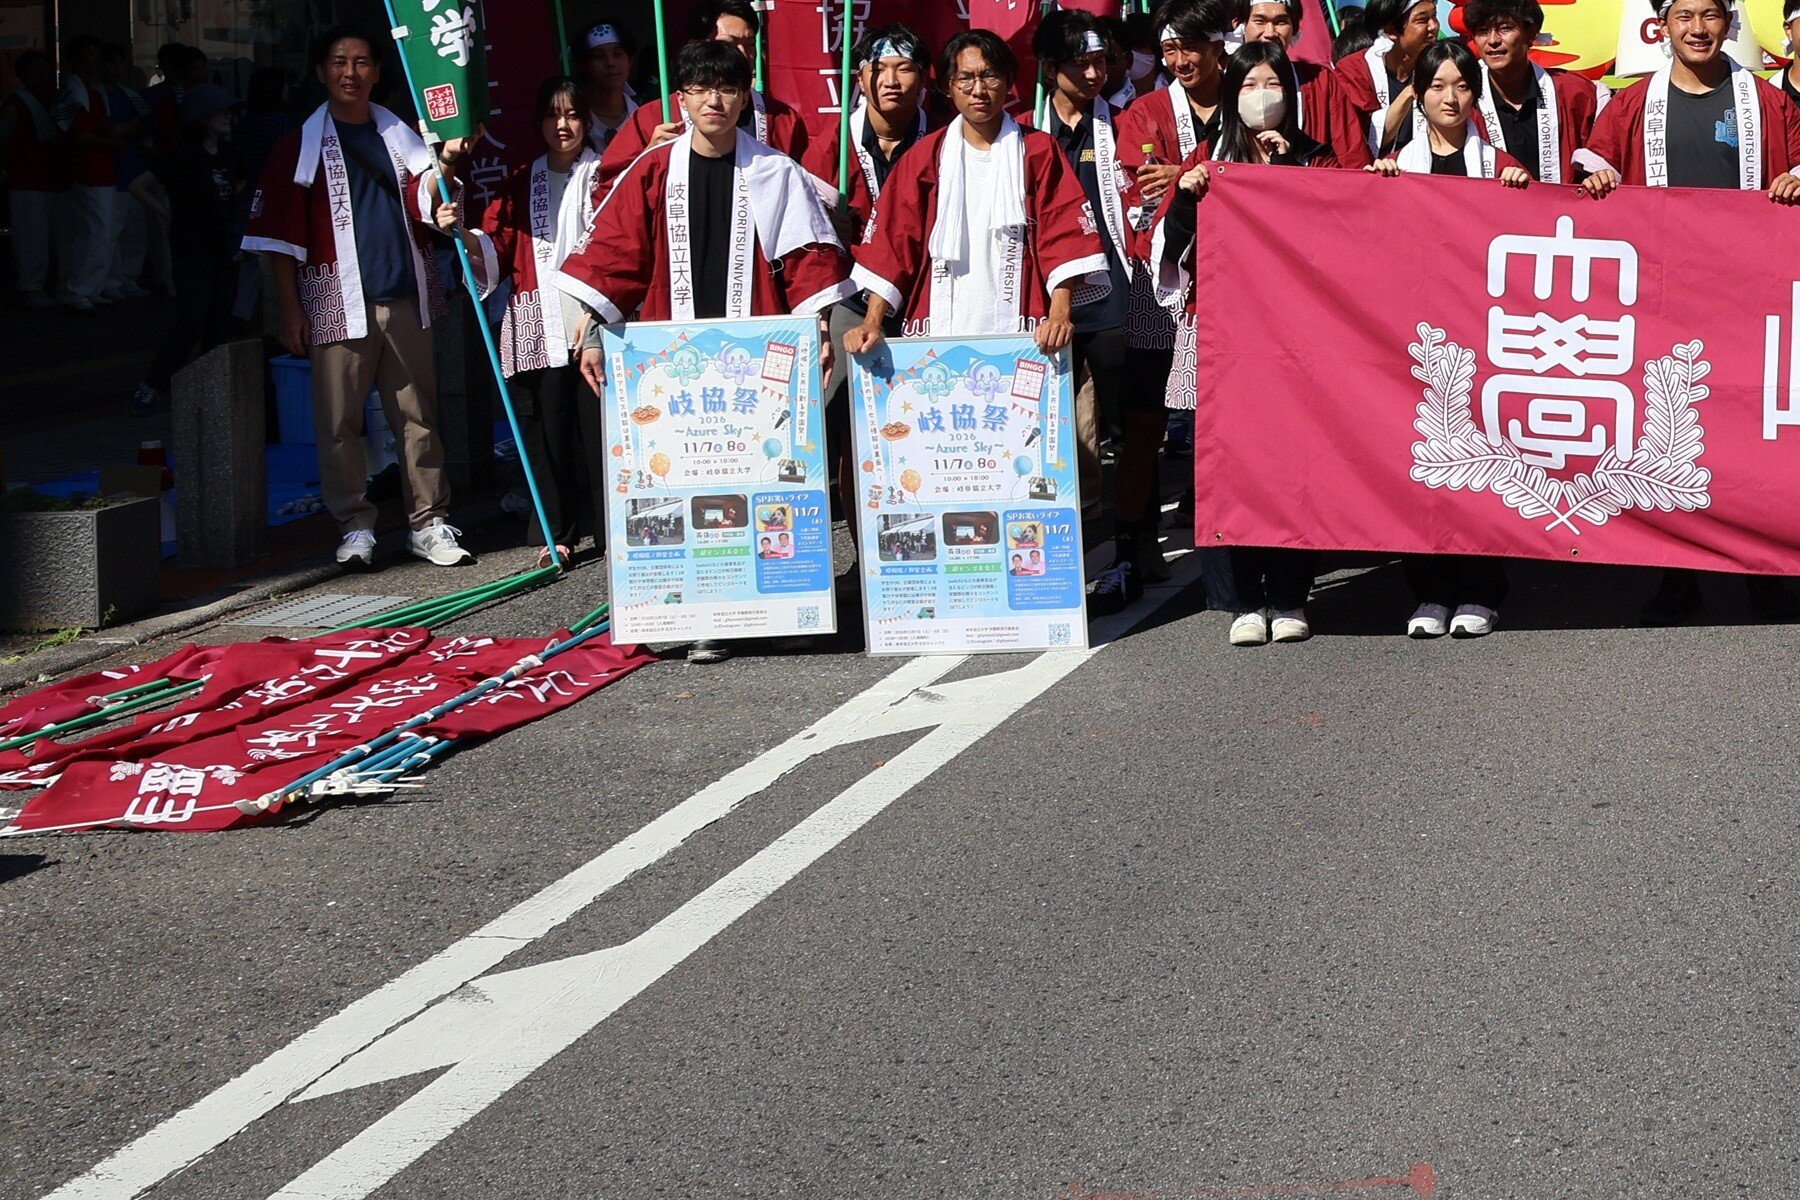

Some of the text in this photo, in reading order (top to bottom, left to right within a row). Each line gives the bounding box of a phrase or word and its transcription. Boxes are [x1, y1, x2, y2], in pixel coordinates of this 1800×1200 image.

[1738, 81, 1751, 106] GIFU
[1540, 113, 1551, 157] KYORITSU
[1646, 98, 1667, 187] 岐阜協立
[1743, 108, 1755, 155] KYORITSU
[321, 135, 351, 232] 岐阜協立大学
[1098, 138, 1113, 188] KYORITSU
[531, 168, 554, 264] 岐阜協立大学
[735, 195, 749, 251] KYORITSU
[1103, 188, 1124, 249] UNIVERSITY
[666, 181, 693, 307] 岐阜協立大学
[1002, 237, 1020, 304] UNIVERSITY
[769, 343, 795, 355] BINGO
[1018, 361, 1044, 372] BINGO
[668, 386, 760, 417] 岐協祭
[699, 416, 727, 425] 2026
[917, 403, 1010, 433] 岐協祭
[948, 433, 976, 442] 2026
